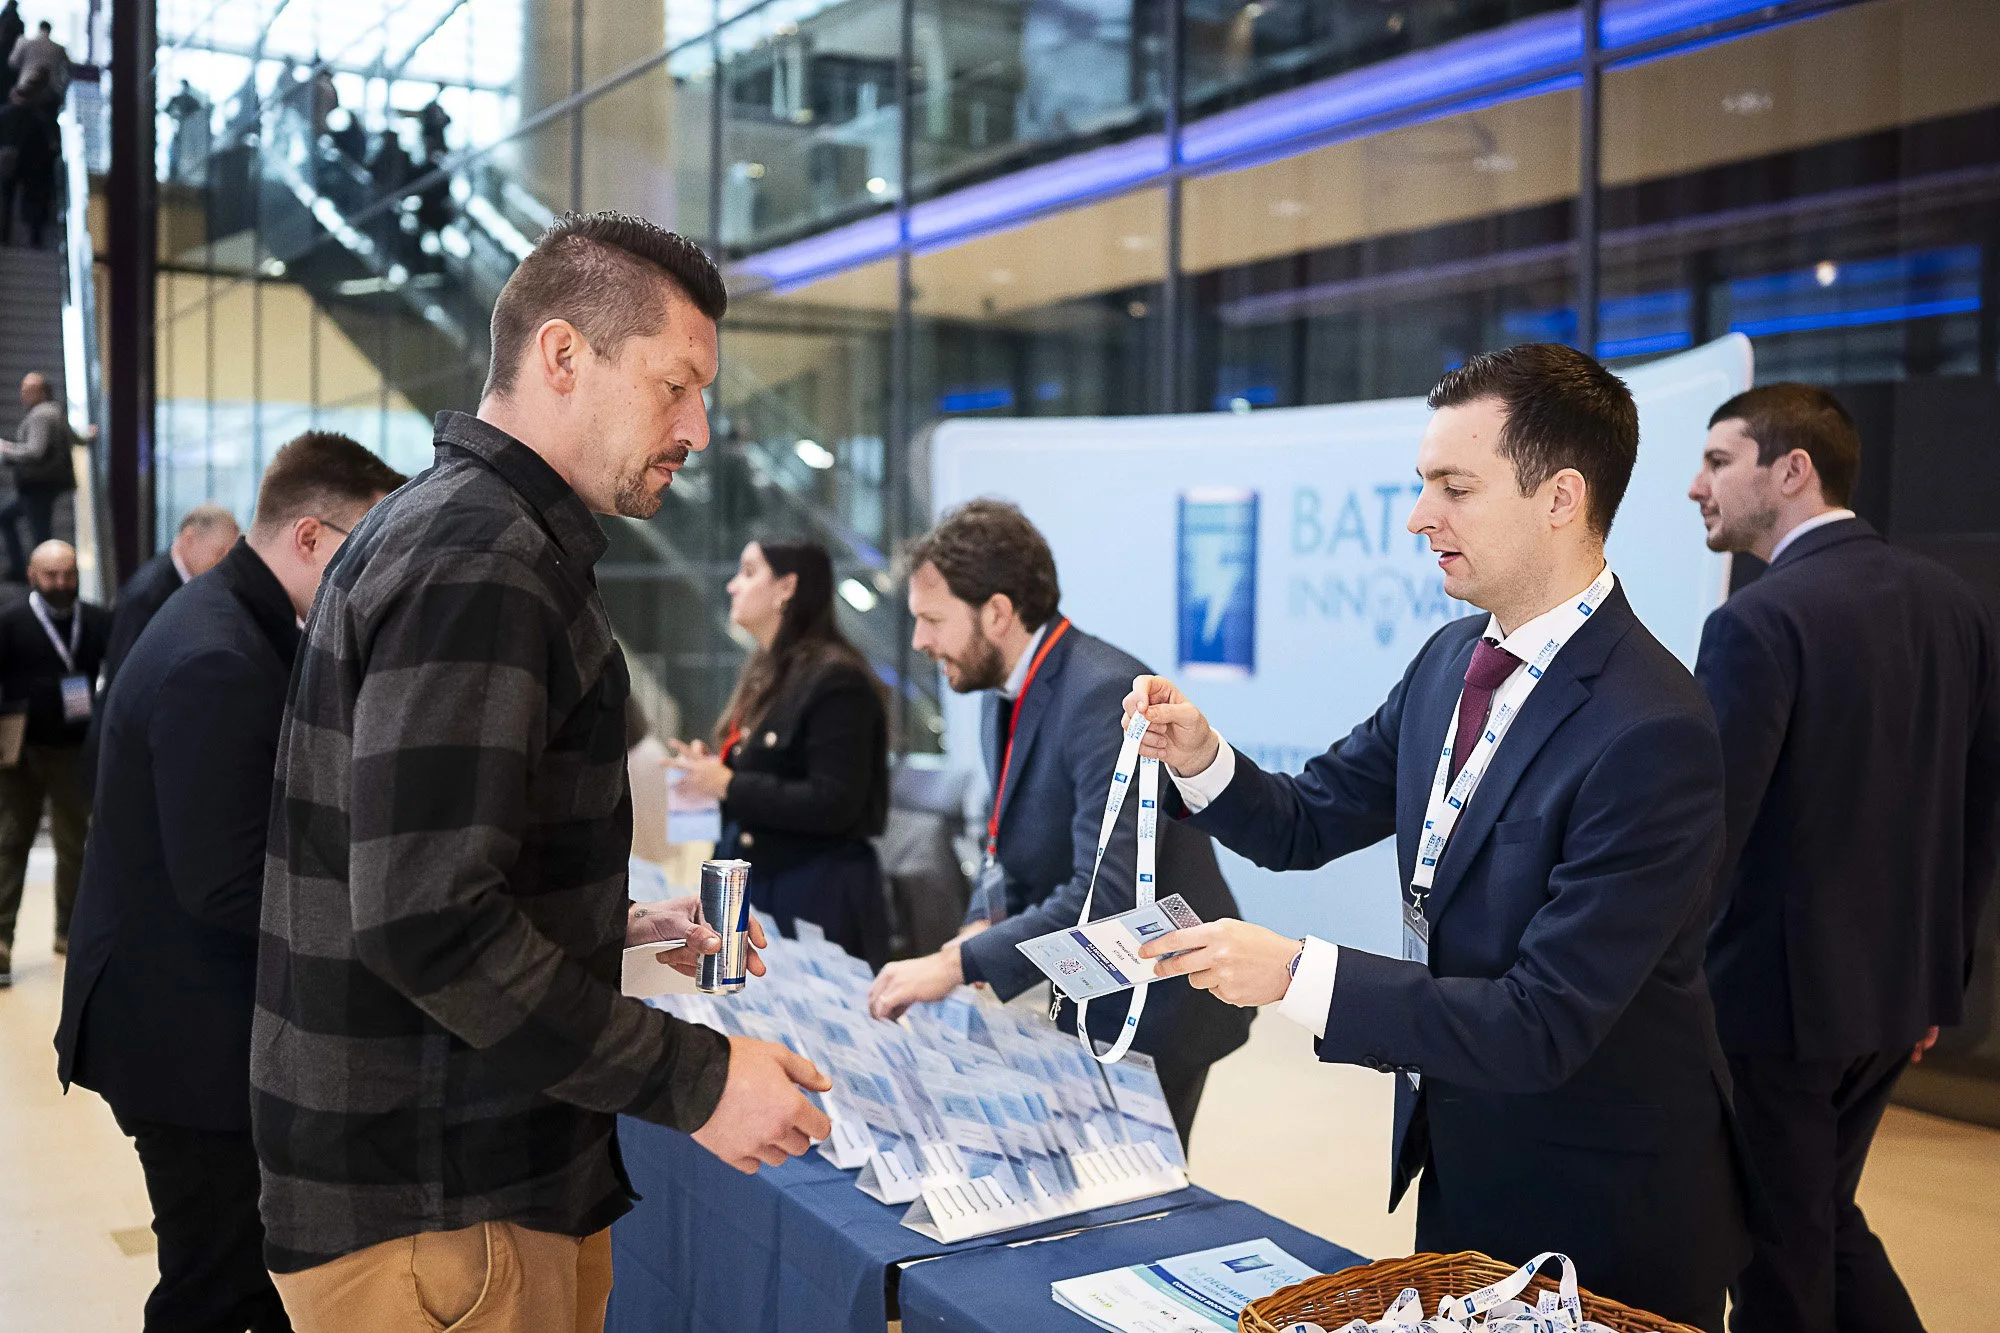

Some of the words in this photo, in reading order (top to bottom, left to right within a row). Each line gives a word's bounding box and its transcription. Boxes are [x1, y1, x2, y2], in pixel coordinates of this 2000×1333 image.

[1534, 638, 1555, 663] BATTERY
[1452, 769, 1468, 796] BATTERY
[1424, 833, 1438, 855] BATTERY
[1474, 1288, 1495, 1299] BATTERY
